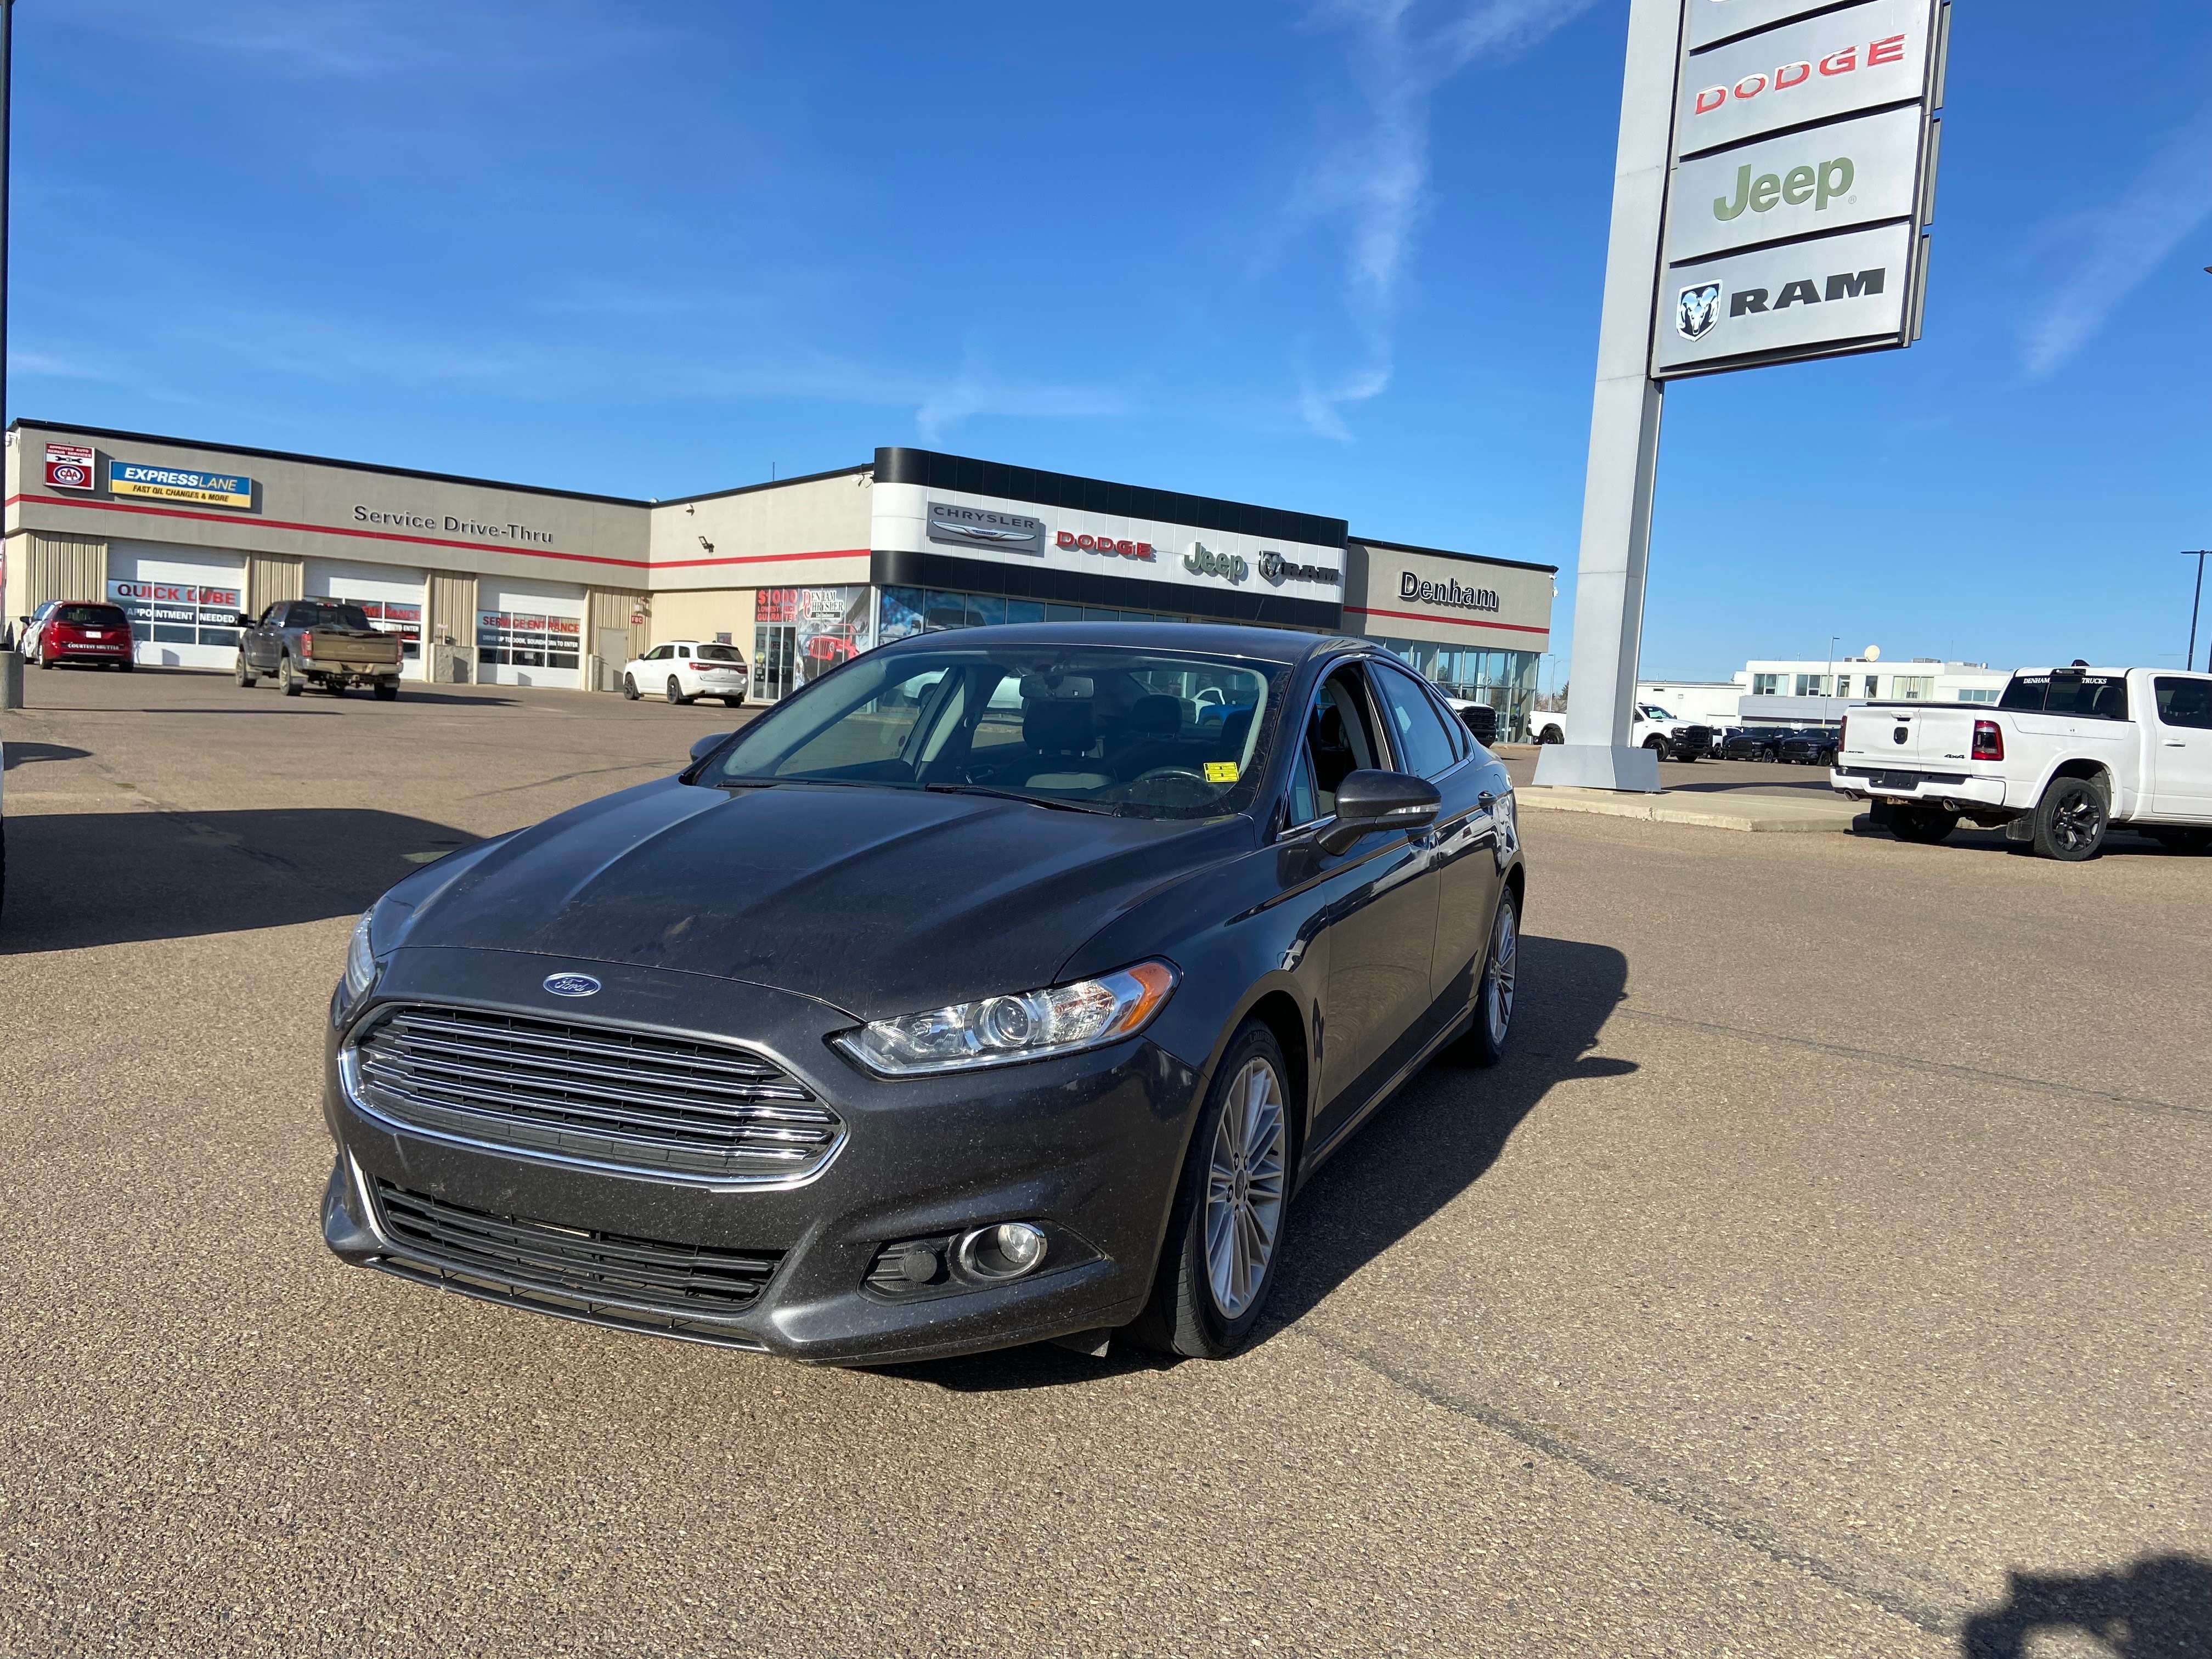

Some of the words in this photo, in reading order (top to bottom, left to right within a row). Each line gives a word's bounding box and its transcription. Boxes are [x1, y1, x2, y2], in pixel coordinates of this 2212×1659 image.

[1695, 33, 1907, 115] DODGE
[1713, 156, 1855, 221] Jeep
[1729, 267, 1886, 318] RAM
[60, 469, 78, 478] CAA
[166, 489, 199, 499] CHANGES
[354, 505, 436, 529] Service
[444, 516, 553, 543] Drive-Thru
[934, 507, 1034, 529] CHRYSLER
[1057, 531, 1151, 557] DODGE
[1184, 542, 1244, 580] Jeep
[1281, 562, 1339, 581] RAM
[117, 584, 180, 601] QUICK
[187, 589, 236, 606] LUBE
[803, 591, 836, 606] DENHAM
[1399, 571, 1498, 608] Denham
[127, 608, 194, 620] APPONTMENT
[804, 601, 843, 618] CHRYSLER
[482, 616, 525, 629] SERVCE
[527, 619, 579, 633] ENTRANCE
[554, 978, 589, 992] Ford
